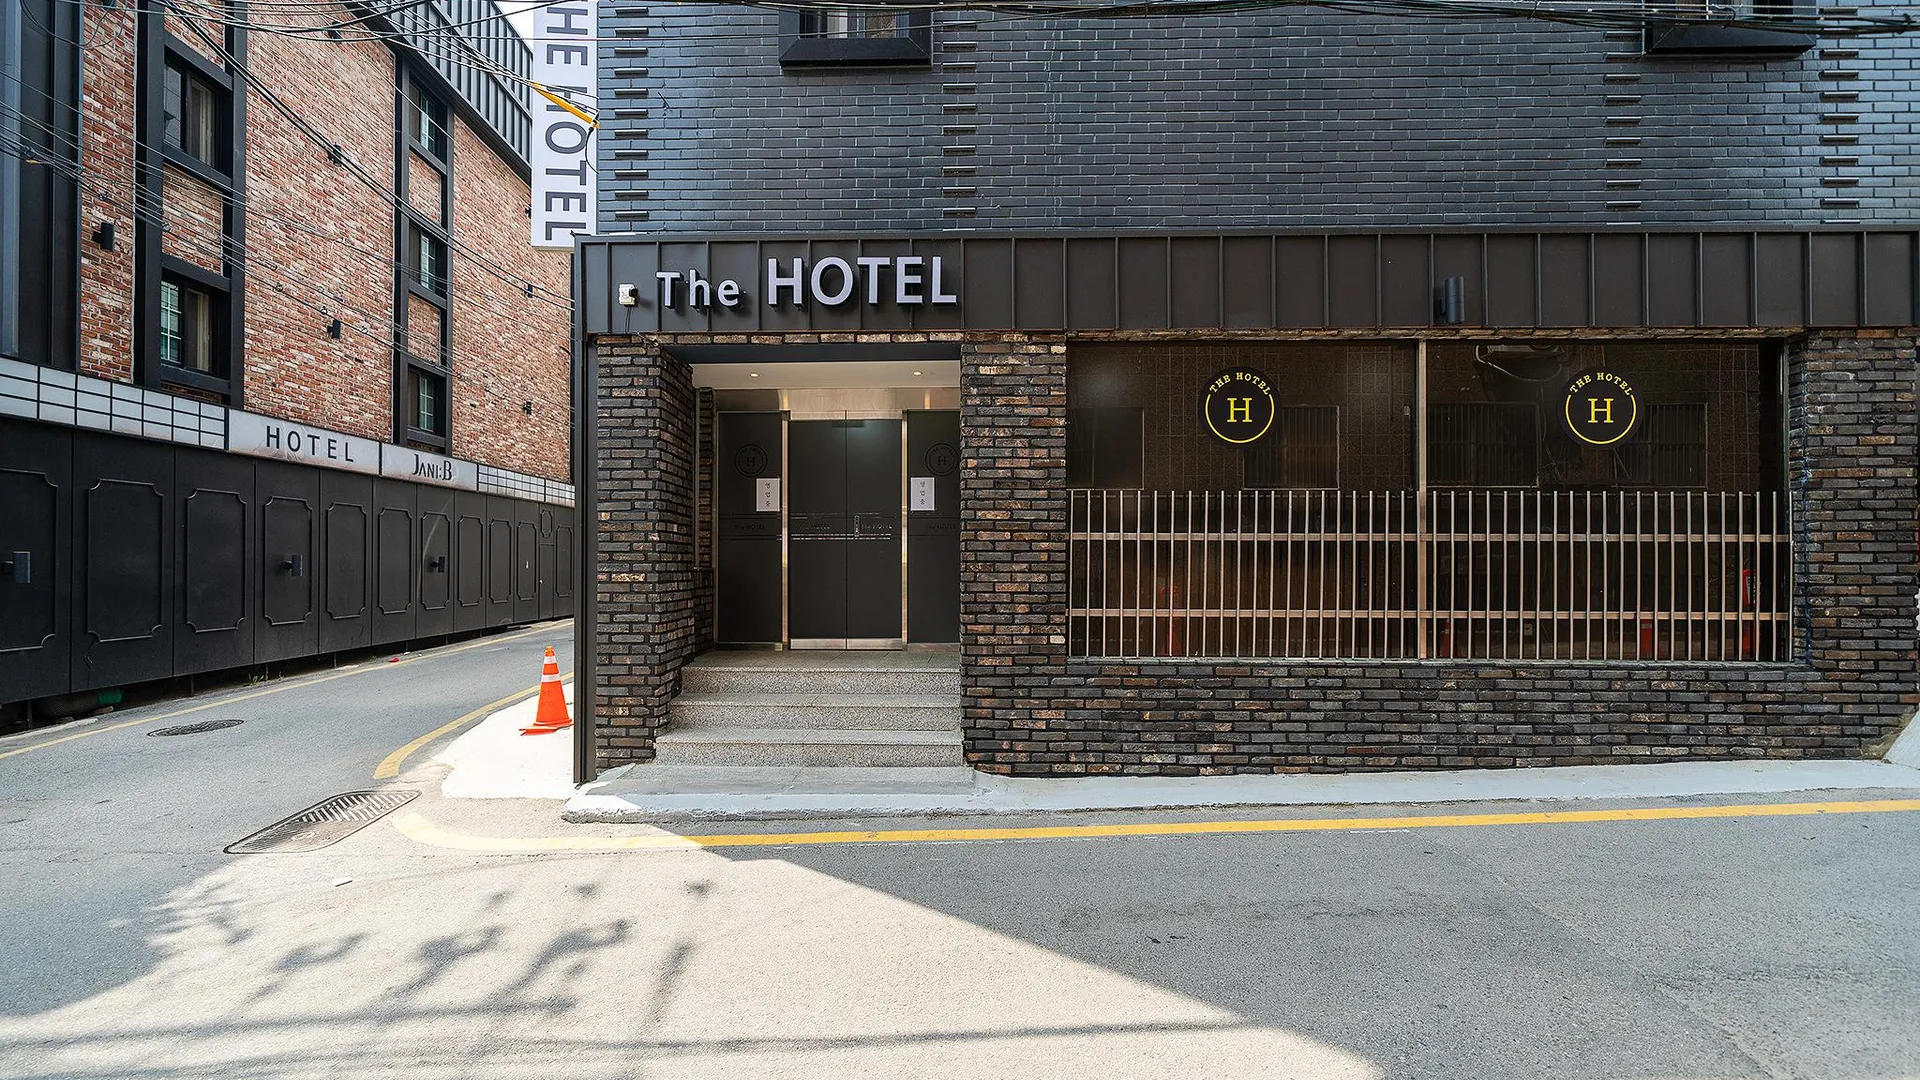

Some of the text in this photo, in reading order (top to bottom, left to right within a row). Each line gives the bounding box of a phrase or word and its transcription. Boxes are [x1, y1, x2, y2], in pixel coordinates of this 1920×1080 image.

[545, 0, 588, 241] HE HOTEL
[656, 256, 957, 308] The HOTEL
[1209, 372, 1271, 395] THE HOTEL
[1569, 372, 1633, 396] THE HOTEL
[1226, 397, 1253, 423] H
[1588, 398, 1614, 423] H
[266, 425, 355, 463] HOTEL
